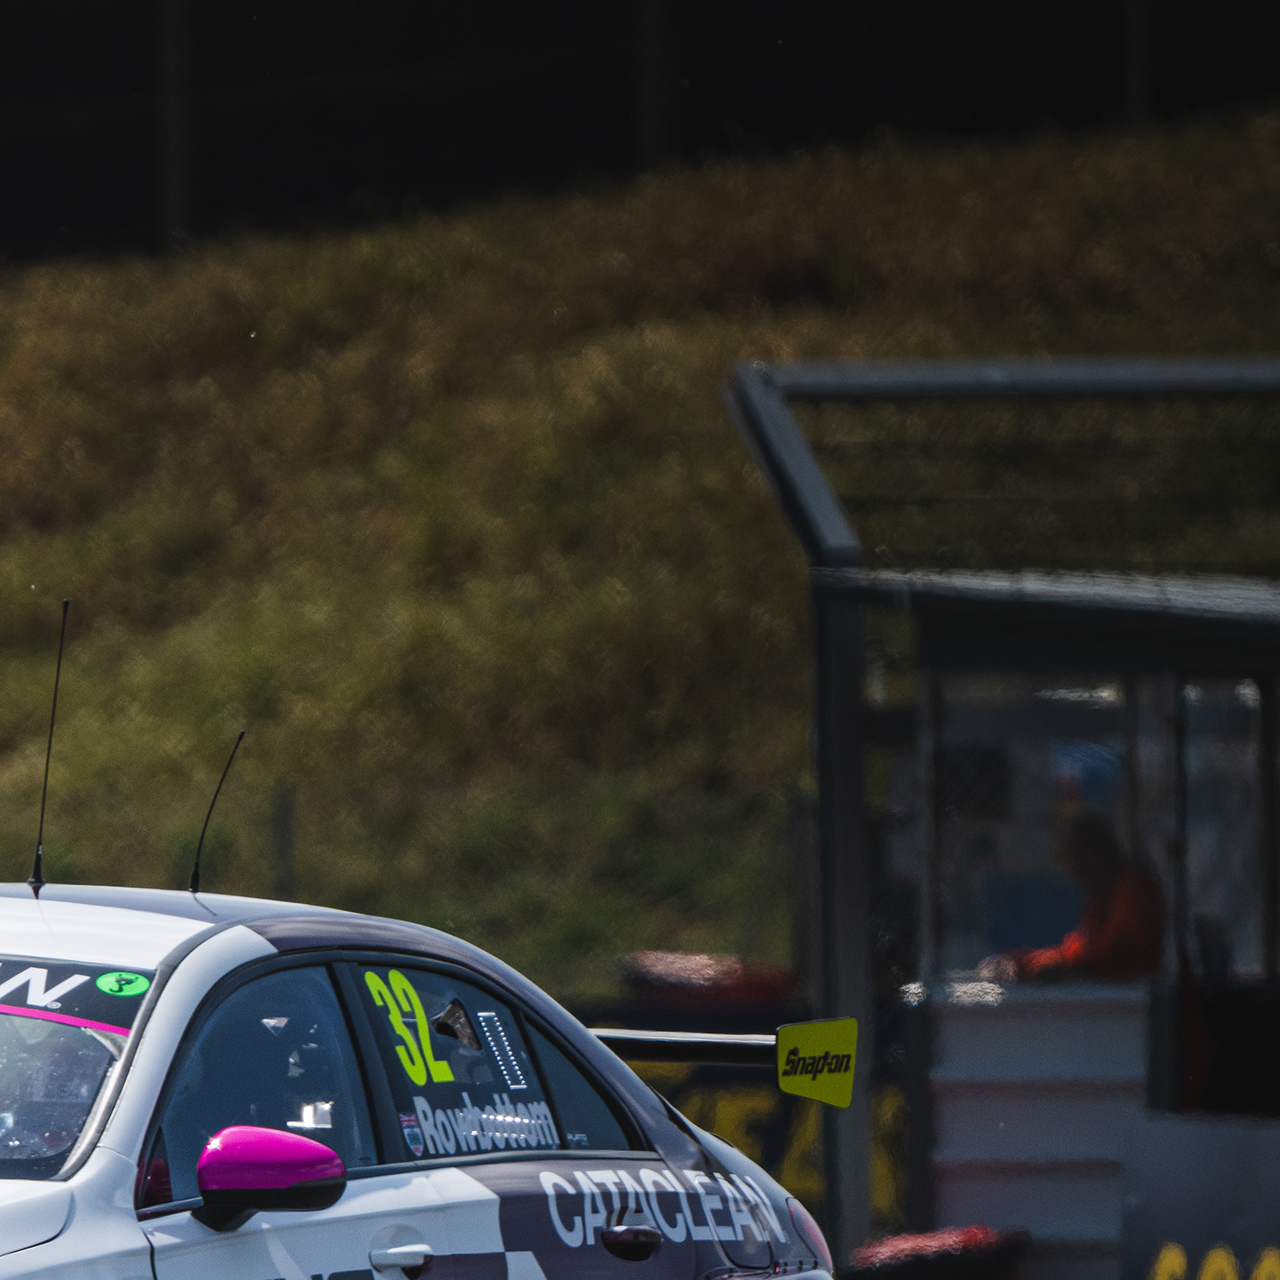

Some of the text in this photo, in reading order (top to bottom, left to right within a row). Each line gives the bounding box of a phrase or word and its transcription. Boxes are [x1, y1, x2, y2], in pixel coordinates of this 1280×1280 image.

[364, 969, 453, 1087] 32
[782, 1046, 851, 1081] Snap-on
[412, 1091, 560, 1155] Rowbottom
[539, 1168, 788, 1248] CATACLEAN
